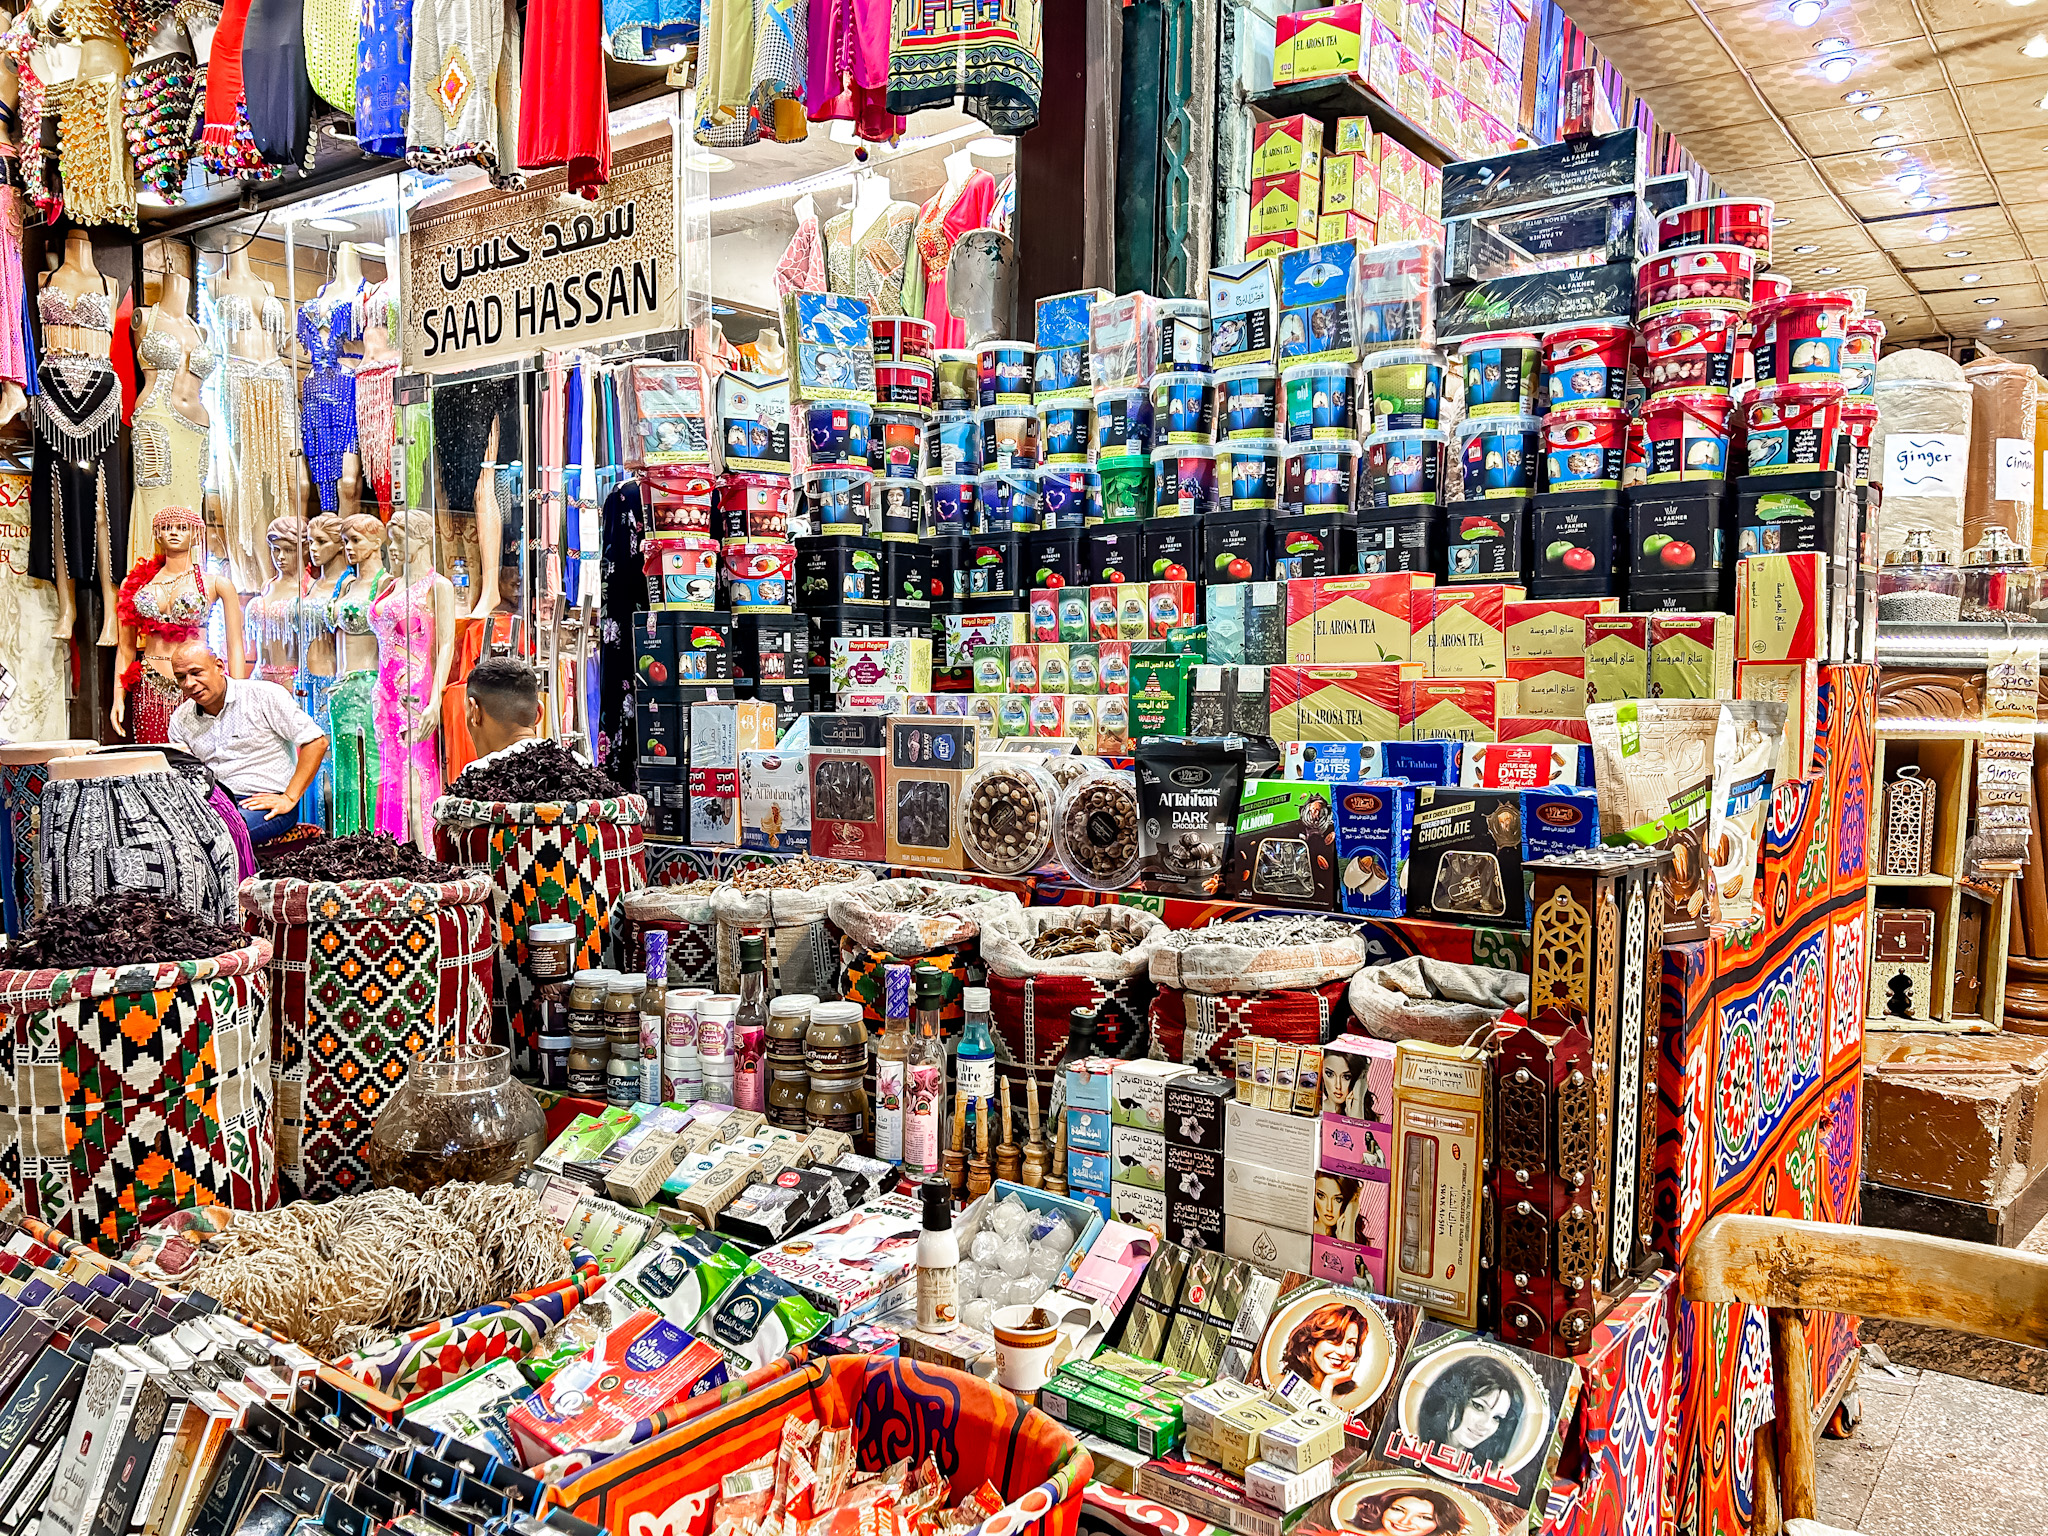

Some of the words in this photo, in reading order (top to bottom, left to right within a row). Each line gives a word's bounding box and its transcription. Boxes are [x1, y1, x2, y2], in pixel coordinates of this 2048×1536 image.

[1296, 41, 1304, 50] EL
[1306, 38, 1324, 49] AROSA
[1326, 35, 1337, 46] TEA
[1573, 150, 1600, 161] FAKHER
[542, 202, 635, 259] سعد
[1528, 232, 1554, 241] FAKHER
[440, 235, 530, 290] حسن
[1568, 280, 1595, 289] FAKHER
[423, 295, 501, 357] SAAD
[515, 258, 657, 338] HASSAN
[1897, 450, 1952, 471] Ginger
[1567, 522, 1588, 530] FAKHER
[1774, 582, 1785, 613] العروسة
[1317, 620, 1327, 635] EL
[1330, 619, 1358, 634] AROSA
[1360, 619, 1376, 633] TEA
[1530, 625, 1558, 636] العروسة
[850, 642, 866, 650] Royal
[867, 642, 888, 650] Regime
[1428, 634, 1438, 647] EL
[1440, 633, 1467, 647] AROSA
[1469, 633, 1484, 646] TEA
[1296, 653, 1310, 662] 100
[1590, 653, 1618, 665] العروسة
[1656, 653, 1685, 665] العروسة
[1531, 685, 1559, 694] العروسة
[1301, 711, 1312, 724] EL
[1314, 710, 1343, 725] AROSA
[1345, 709, 1363, 725] TEA
[1417, 728, 1428, 741] EL
[1430, 729, 1458, 741] AROSA
[1459, 729, 1475, 742] TEA
[1315, 763, 1350, 774] DATES
[1498, 768, 1536, 779] DATES
[1500, 778, 1520, 787] Stuffed
[1172, 811, 1209, 823] DARK
[1432, 808, 1456, 819] CHOCOLATE
[1457, 804, 1471, 813] DATES
[1240, 813, 1274, 831] ALMOND
[1419, 820, 1471, 843] CHOCOLATE
[963, 1064, 973, 1073] Dr
[1444, 1070, 1463, 1079] SWAK
[1169, 1092, 1193, 1101] الكابتن
[1169, 1148, 1193, 1158] الكابتن
[1439, 1184, 1447, 1206] SWAK
[1174, 1202, 1198, 1212] الكابتن
[1179, 1306, 1203, 1319] ORIGINAL
[1208, 1317, 1232, 1330] ORIGINAL
[629, 1338, 666, 1369] Sobya
[1384, 1428, 1467, 1482] الكابتن
[1469, 1460, 1522, 1496] حناء
